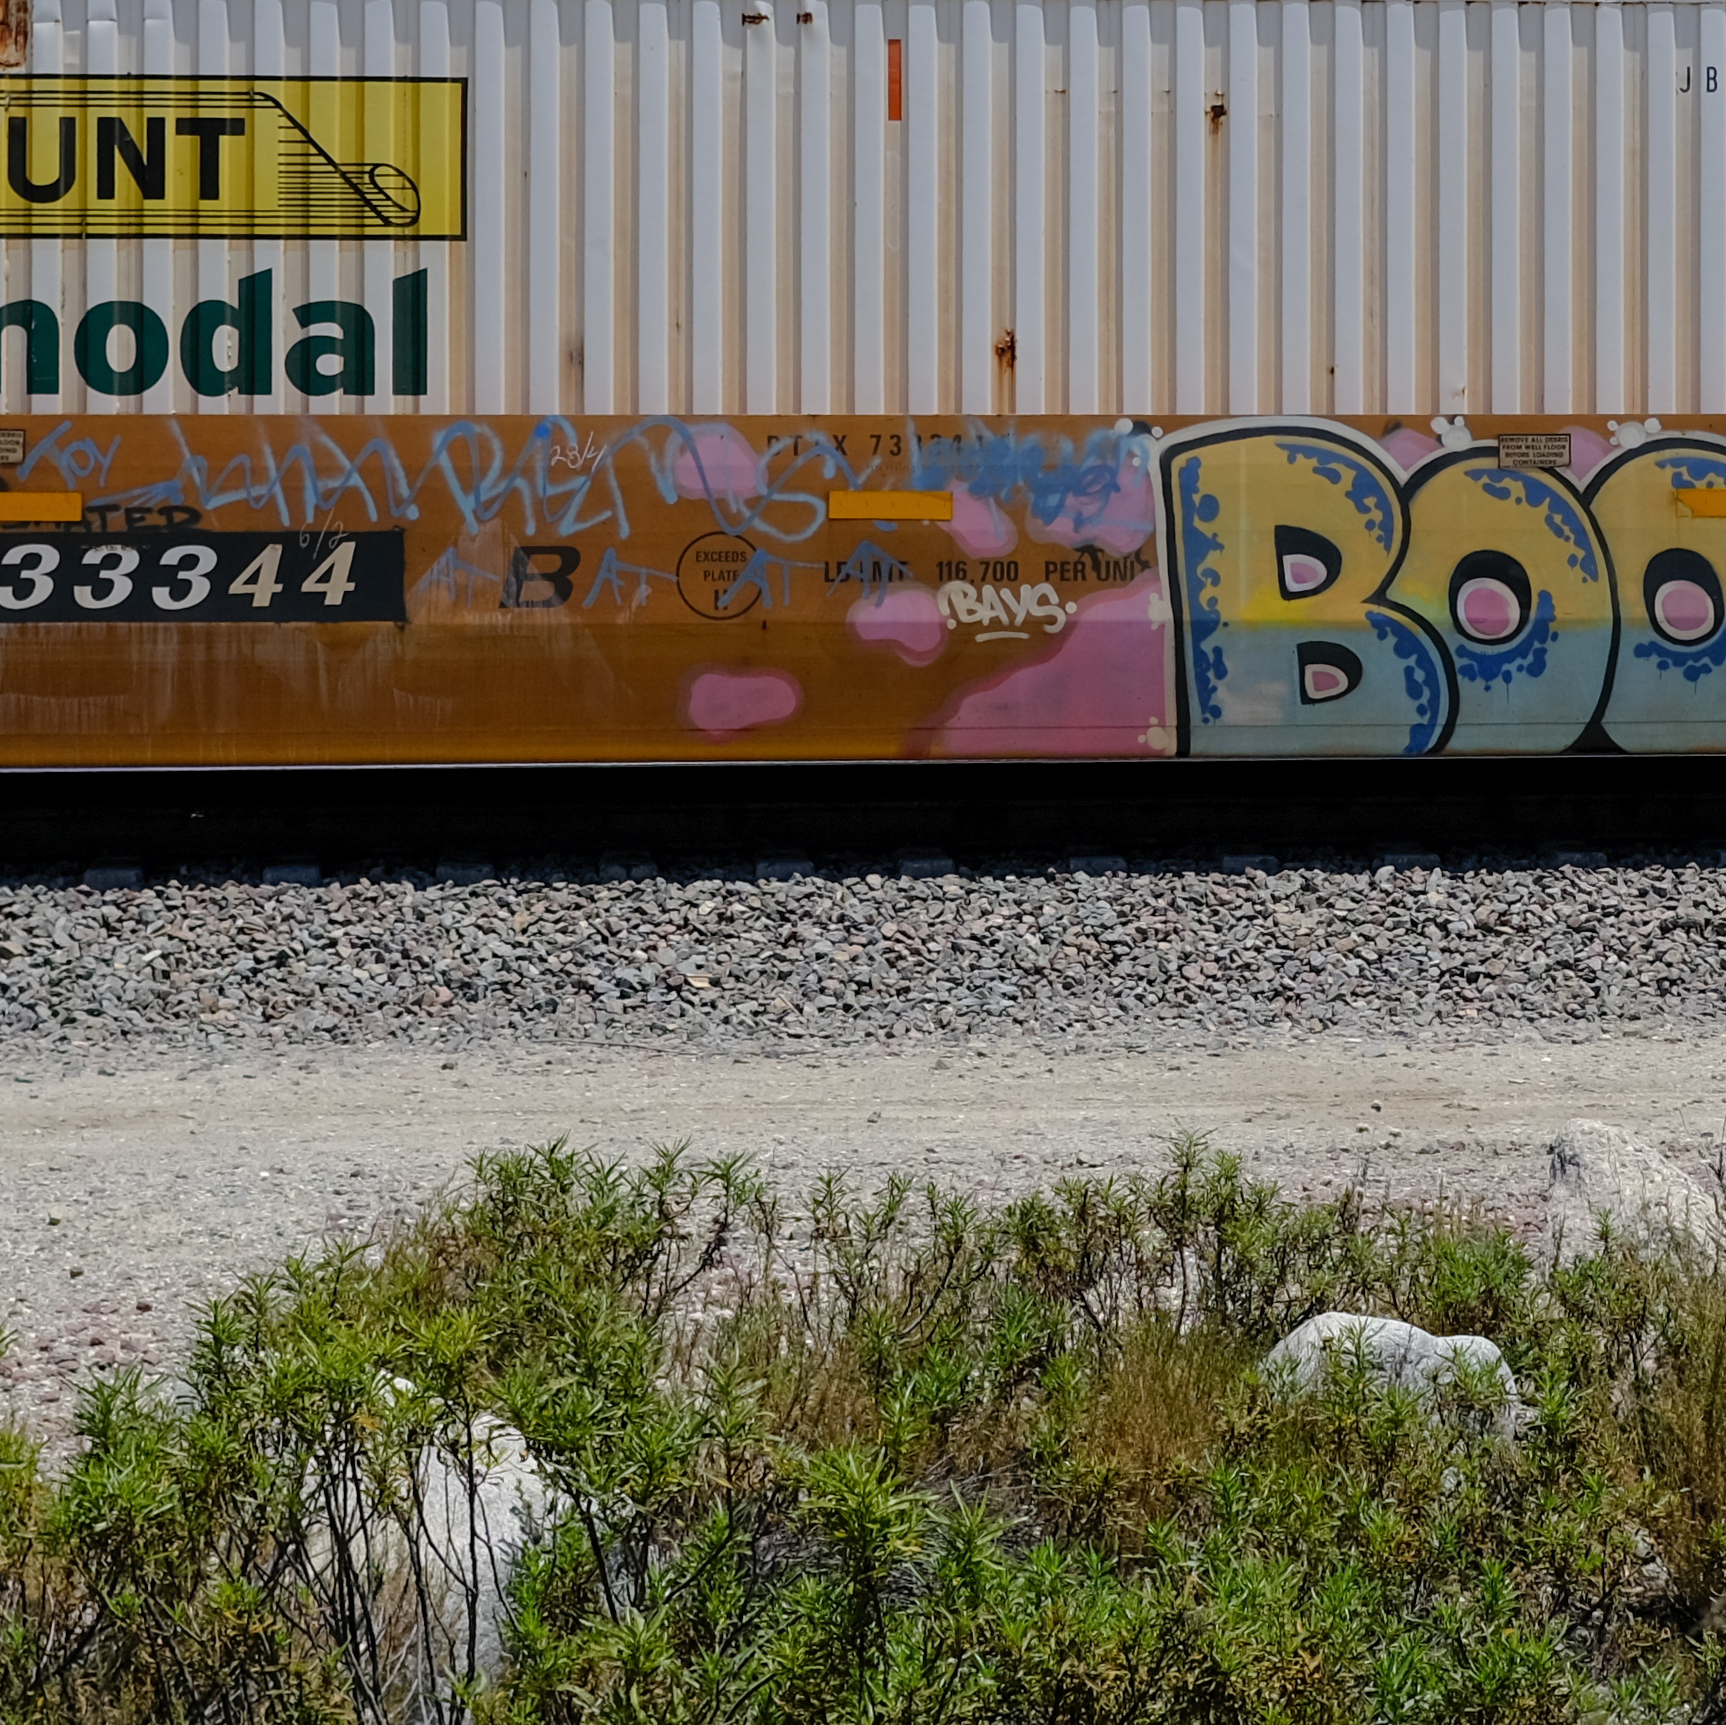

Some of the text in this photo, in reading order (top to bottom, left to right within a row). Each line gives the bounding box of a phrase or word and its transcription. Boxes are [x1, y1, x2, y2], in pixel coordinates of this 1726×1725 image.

[695, 549, 747, 564] EXCEEDS
[703, 569, 740, 583] PLATE
[936, 560, 1019, 587] 116,700
[1044, 560, 1086, 582] PER
